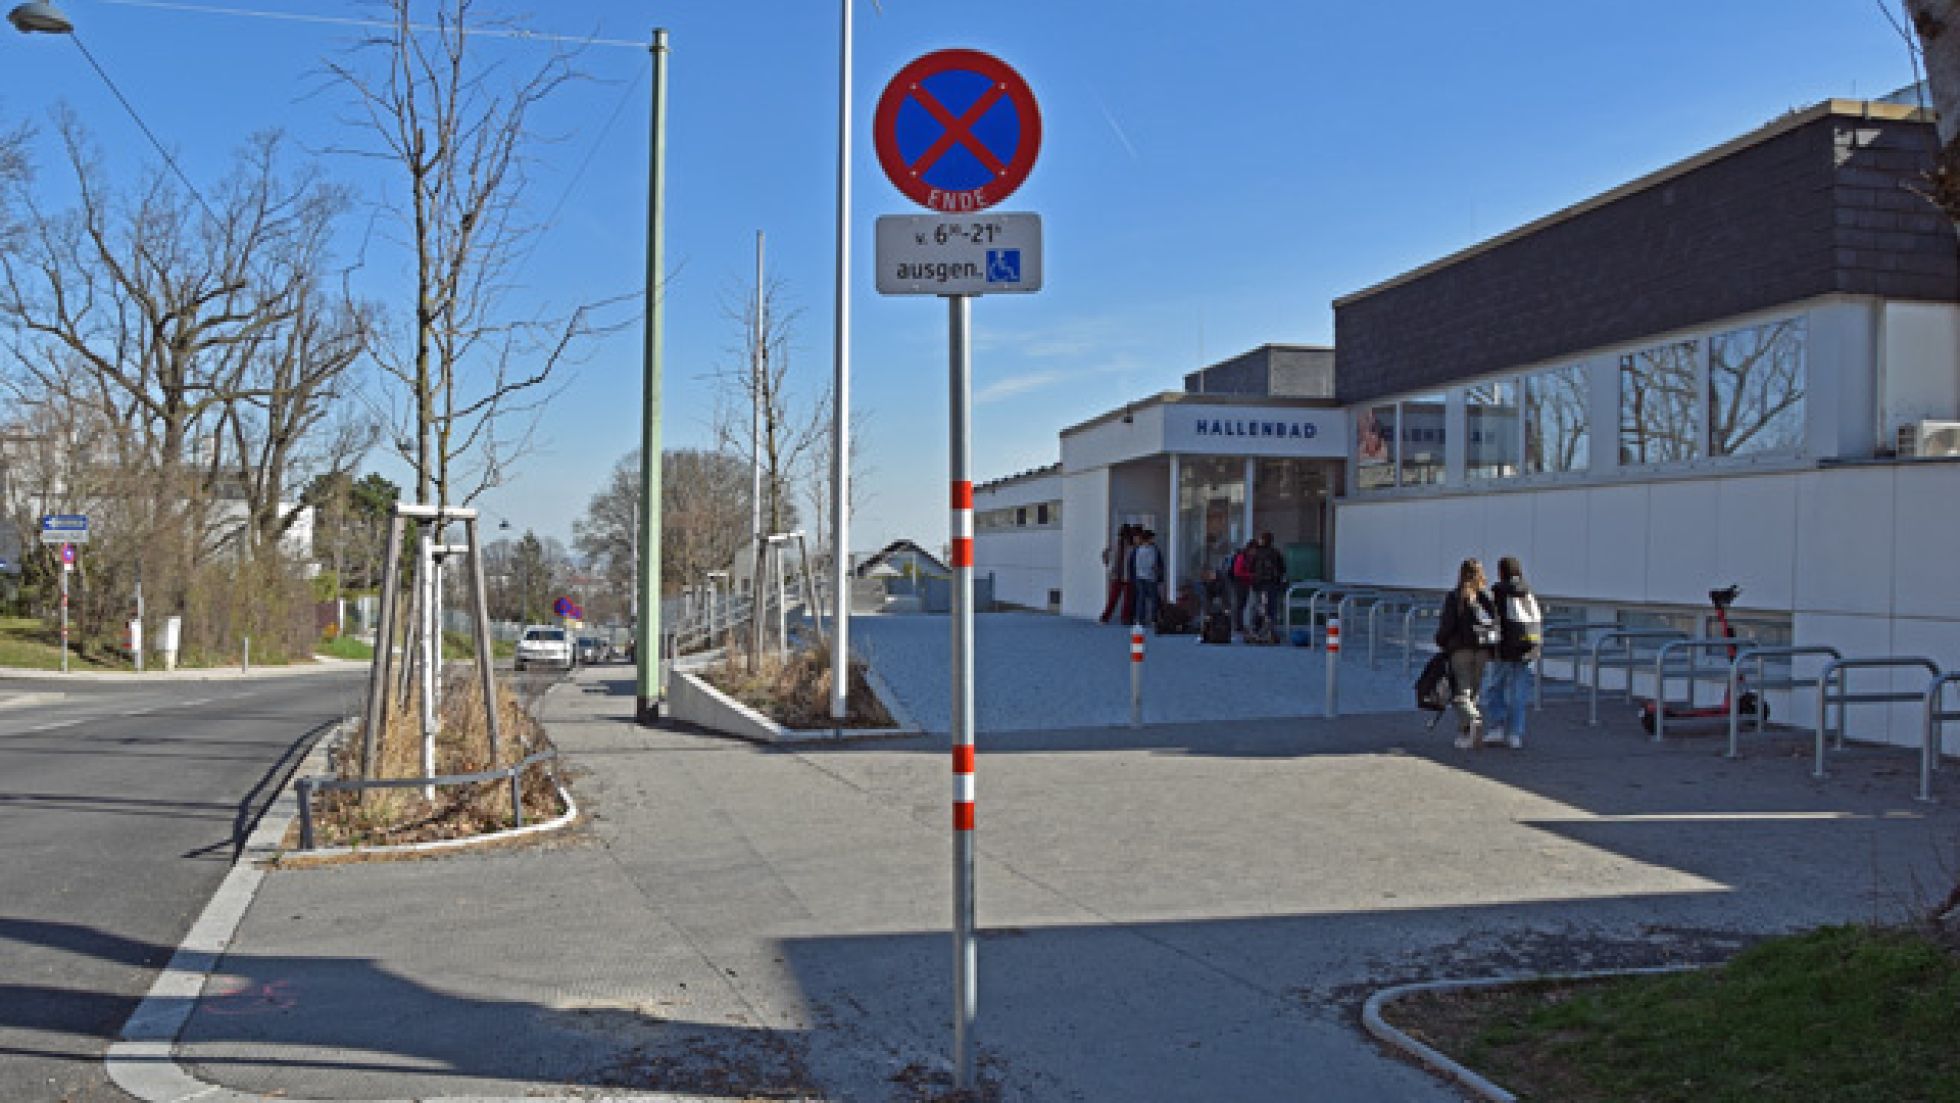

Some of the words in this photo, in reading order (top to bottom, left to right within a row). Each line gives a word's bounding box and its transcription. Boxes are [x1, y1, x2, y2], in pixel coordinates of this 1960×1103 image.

[927, 186, 988, 209] ENDE
[896, 262, 984, 283] ausgen.
[1196, 419, 1318, 439] HALLENBAD
